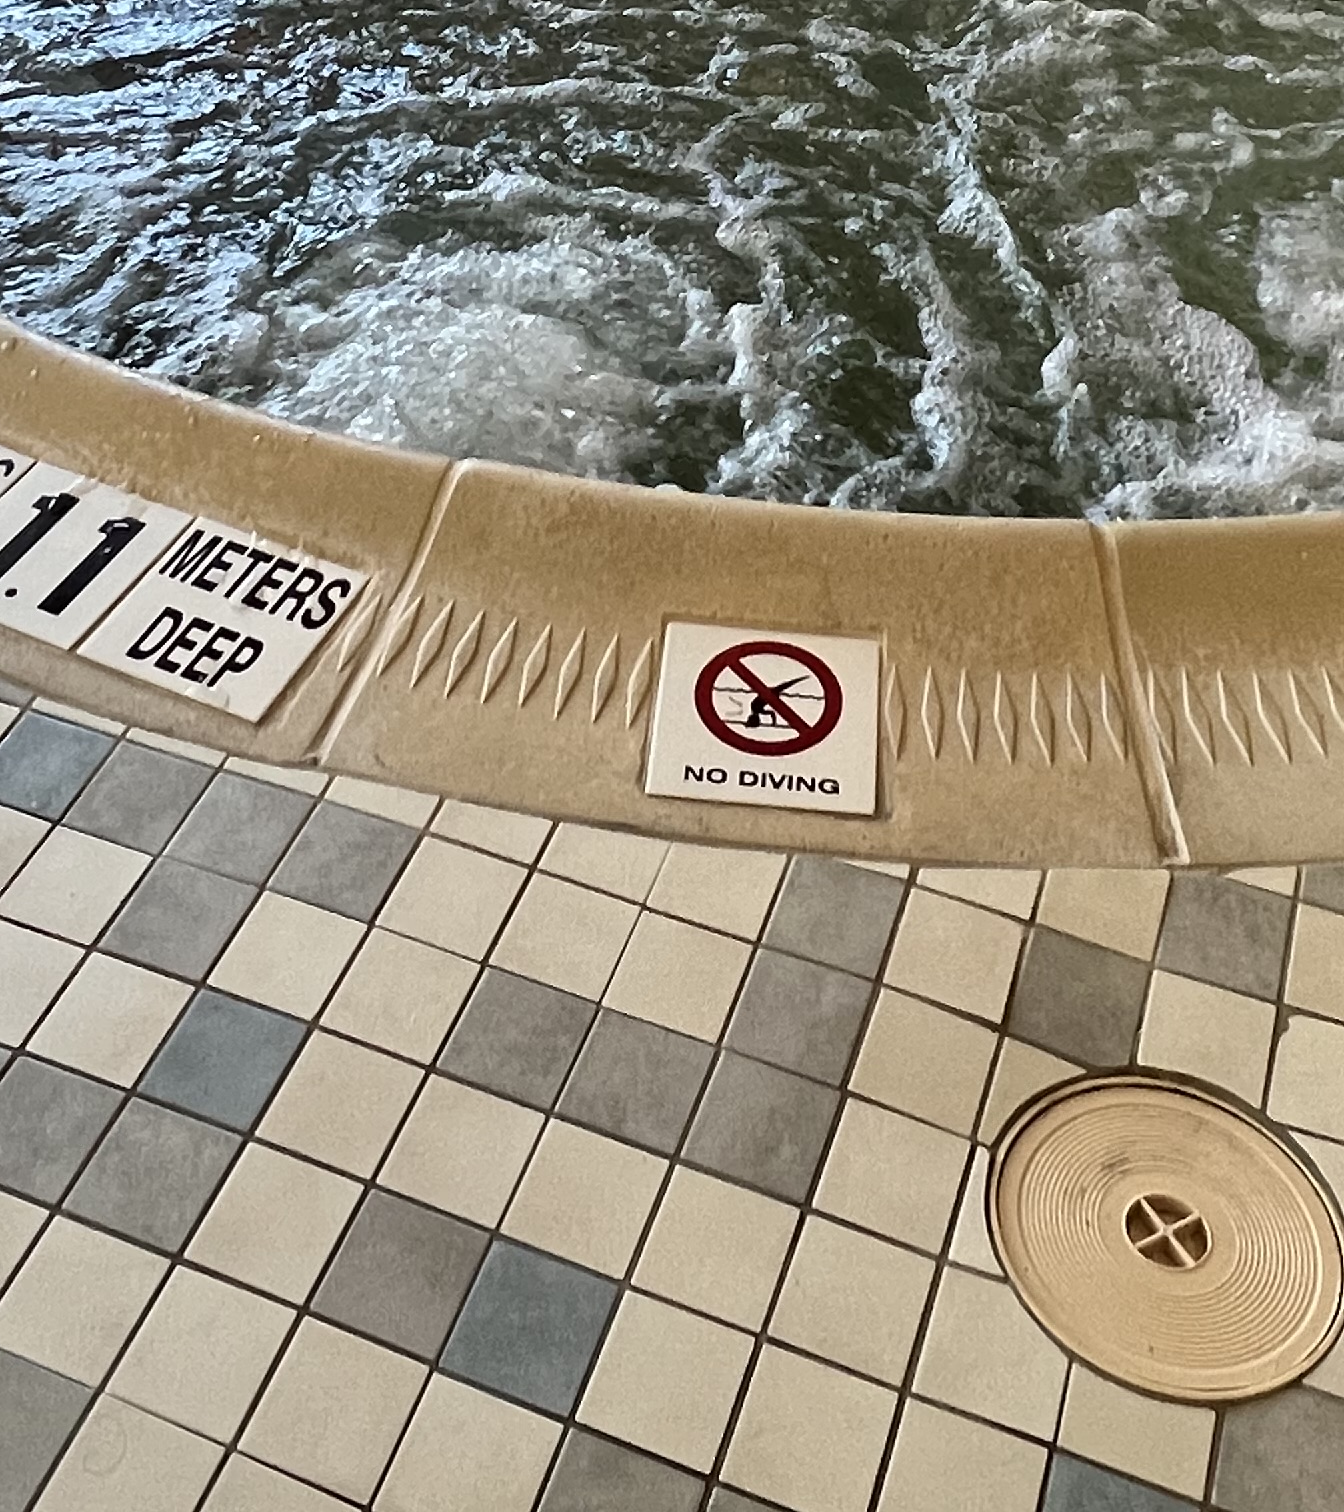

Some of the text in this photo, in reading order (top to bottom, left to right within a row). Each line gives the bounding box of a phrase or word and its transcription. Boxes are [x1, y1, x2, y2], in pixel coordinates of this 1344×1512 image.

[160, 527, 353, 630] METERS
[126, 605, 265, 688] DEEP
[684, 764, 841, 795] NO DIVING
